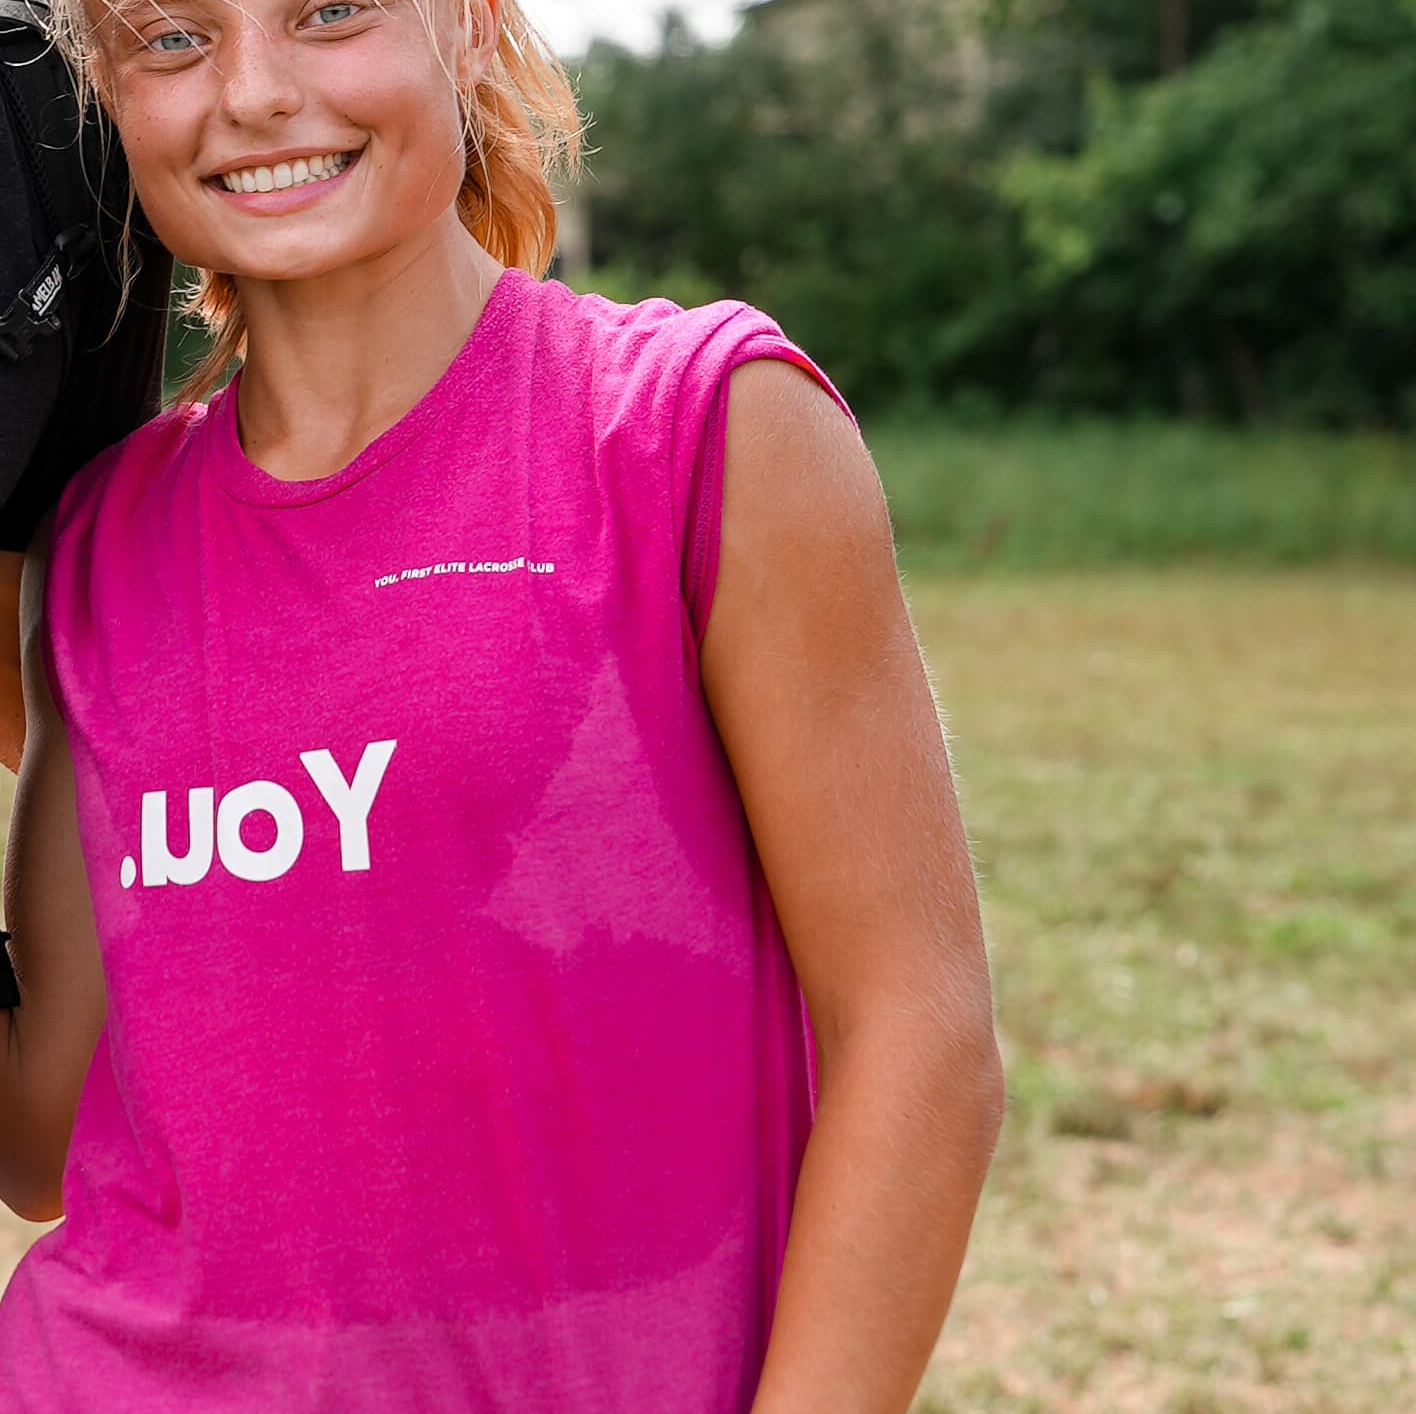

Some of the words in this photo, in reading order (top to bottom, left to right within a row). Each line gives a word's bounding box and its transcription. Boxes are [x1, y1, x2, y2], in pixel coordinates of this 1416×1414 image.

[374, 574, 400, 589] YOU.
[400, 566, 433, 581] FIRST
[433, 562, 467, 575] ELITE
[468, 556, 525, 573] LACROSSE
